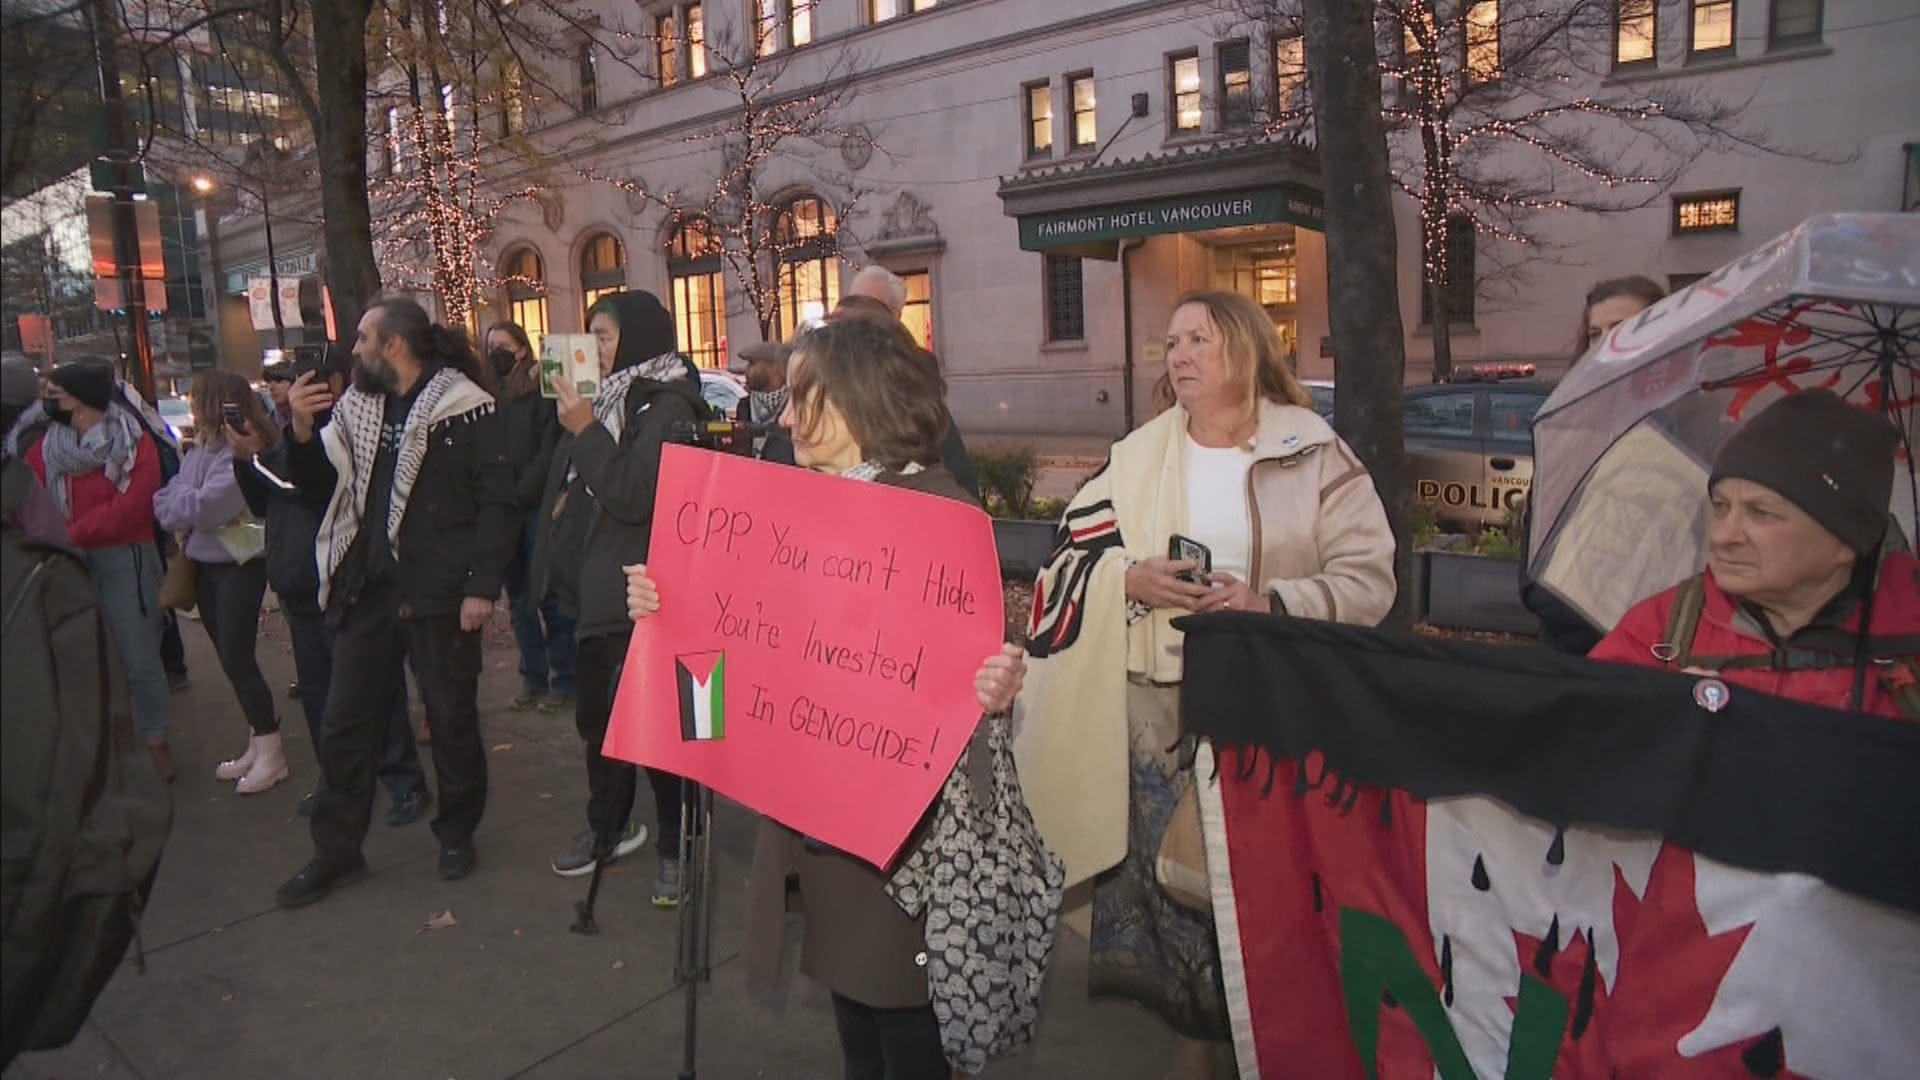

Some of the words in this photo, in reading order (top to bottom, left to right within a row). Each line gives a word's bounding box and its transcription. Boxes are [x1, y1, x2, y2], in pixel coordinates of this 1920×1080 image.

[1038, 216, 1104, 238] FAIRMONT
[1111, 210, 1155, 228] HOTEL
[1161, 199, 1252, 222] VANCOUVER
[1417, 479, 1524, 512] POLIC
[771, 523, 809, 573] You
[822, 548, 899, 590] can't
[922, 562, 976, 615] Hide
[714, 592, 781, 649] You're
[803, 620, 923, 691] Invested
[747, 684, 775, 725] In
[789, 697, 940, 770] GENOCIDE!
